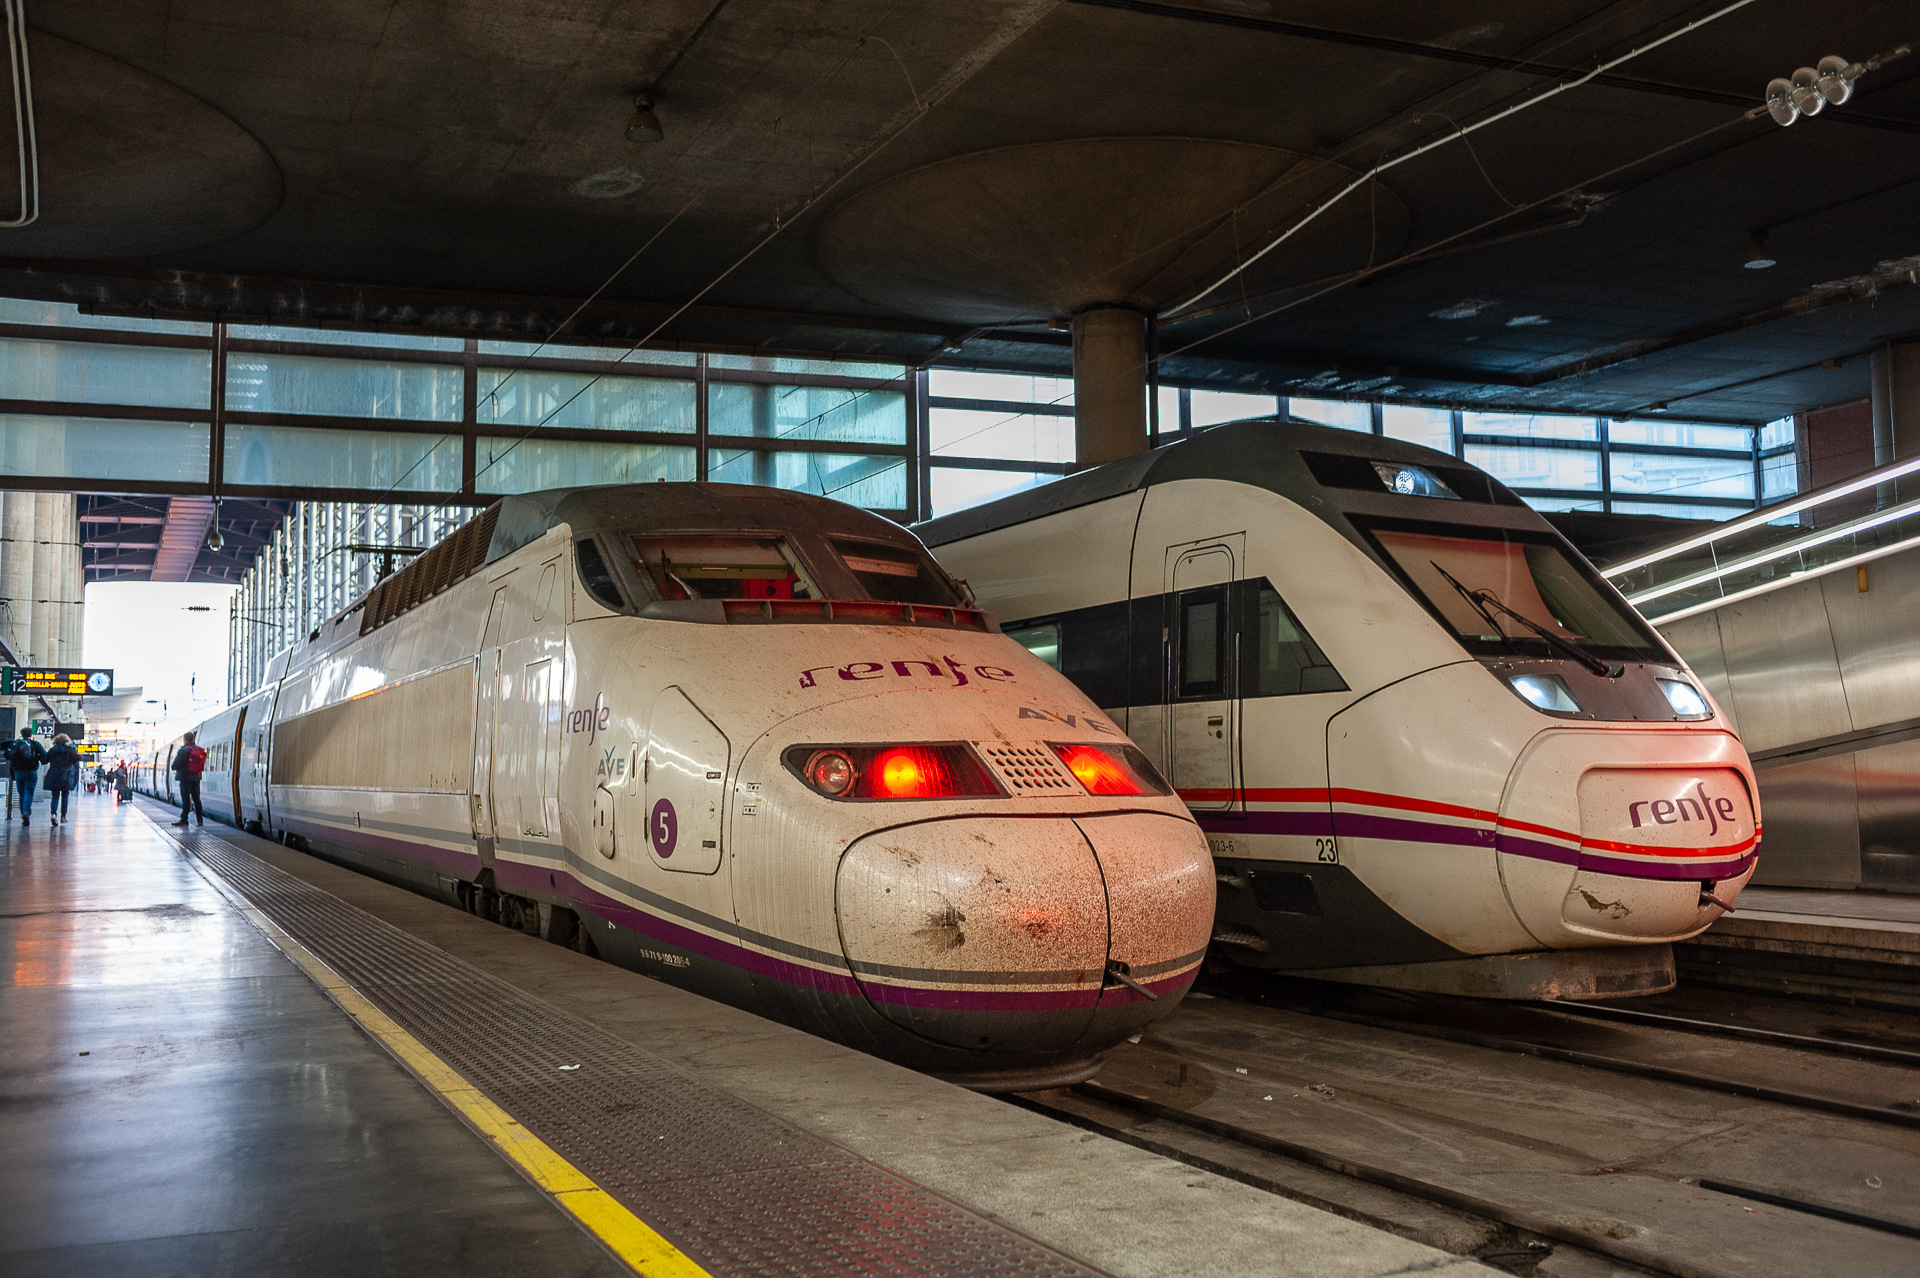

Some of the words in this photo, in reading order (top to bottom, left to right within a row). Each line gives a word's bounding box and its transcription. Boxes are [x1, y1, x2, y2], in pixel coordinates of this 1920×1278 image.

[10, 679, 27, 692] 12
[799, 654, 1016, 690] renfe
[36, 726, 53, 735] A12
[566, 691, 610, 747] renfe
[1018, 705, 1117, 736] AVE
[597, 745, 625, 779] AVE
[1628, 782, 1736, 836] renfe
[659, 812, 669, 844] 5
[1316, 838, 1336, 862] 23
